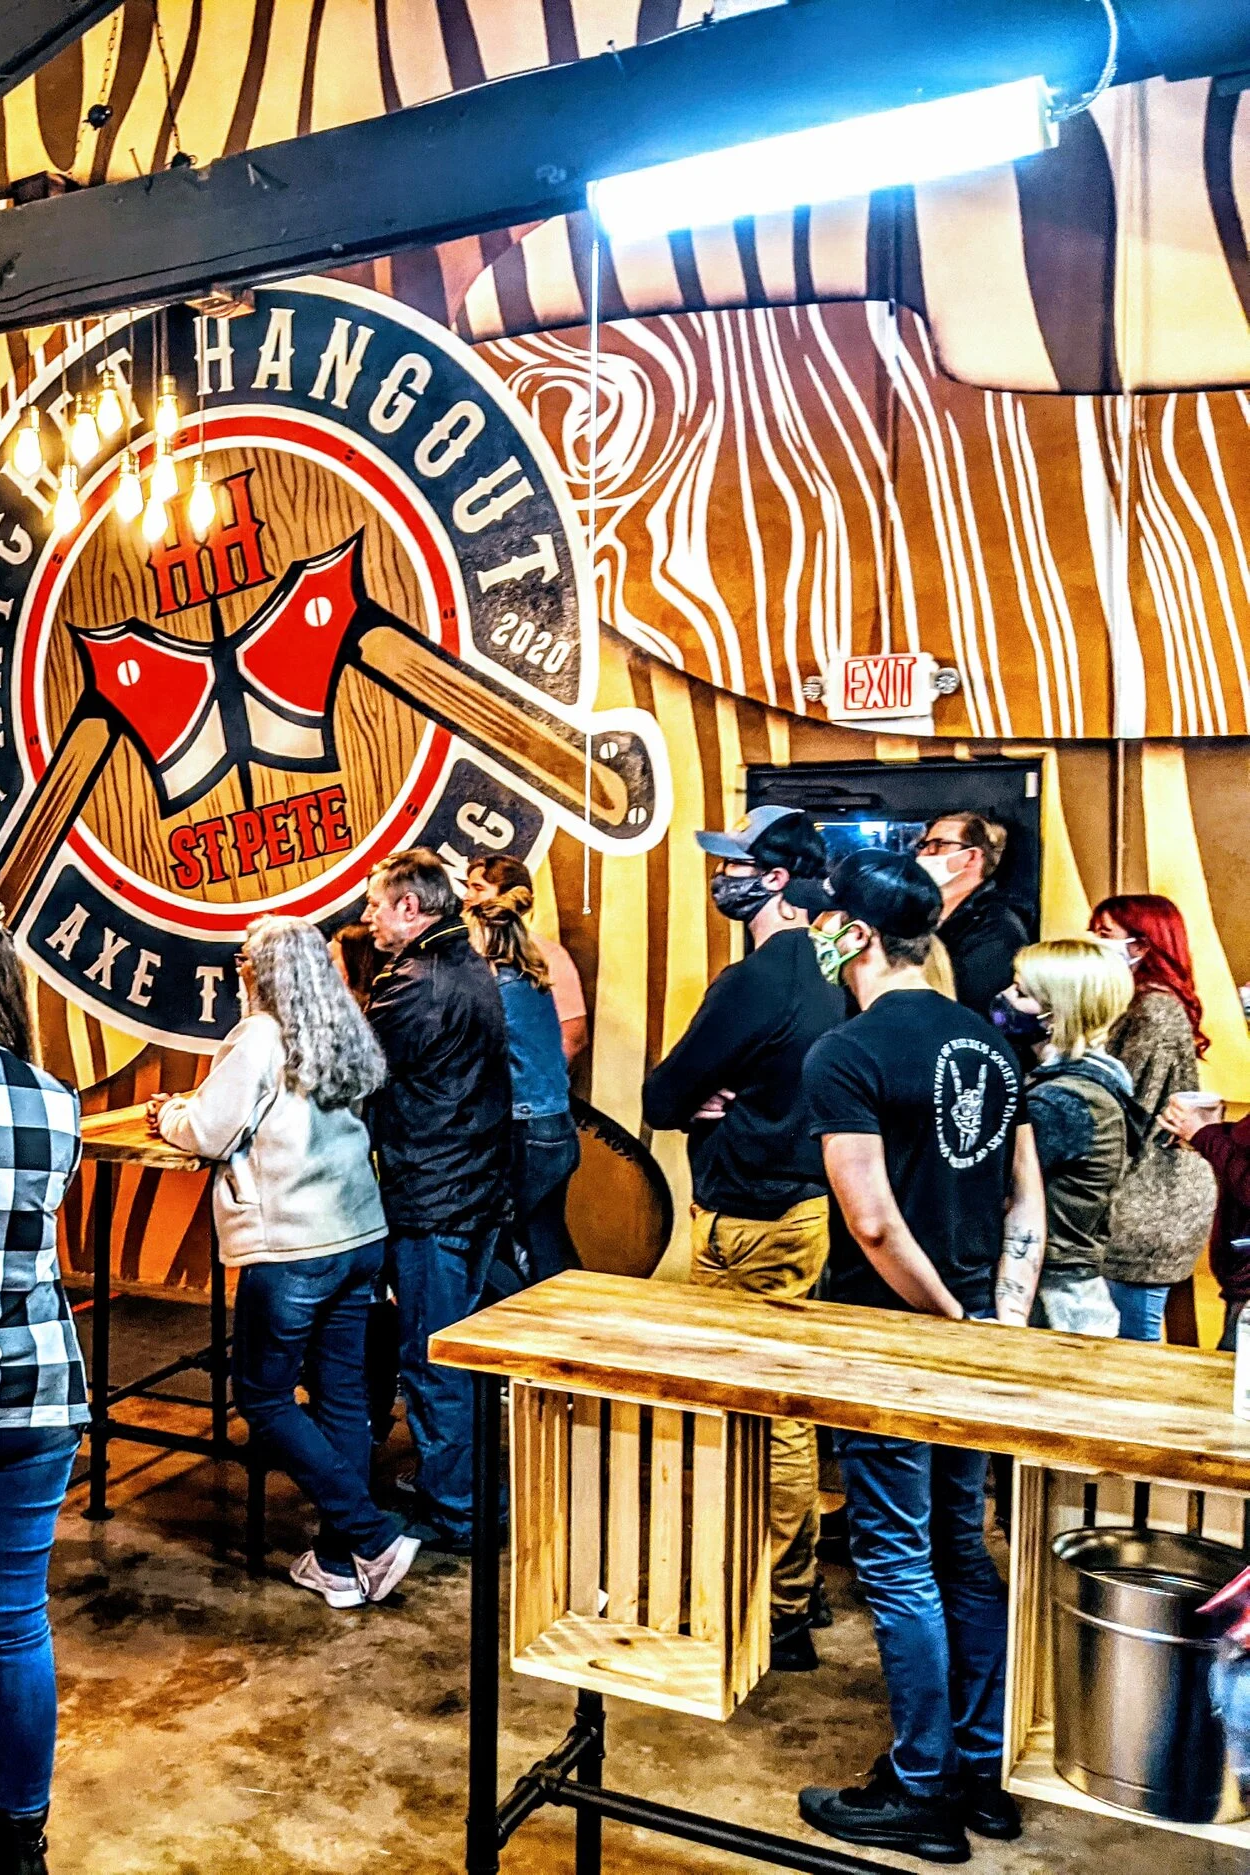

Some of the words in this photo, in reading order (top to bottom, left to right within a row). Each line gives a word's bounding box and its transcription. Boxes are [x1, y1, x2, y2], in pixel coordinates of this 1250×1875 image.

[193, 307, 559, 595] HANGOUT
[146, 467, 276, 619] HH
[490, 611, 572, 676] 2020
[844, 656, 917, 710] EXIT
[170, 818, 228, 891] ST
[228, 786, 352, 876] PETE
[44, 903, 161, 1007] AXE
